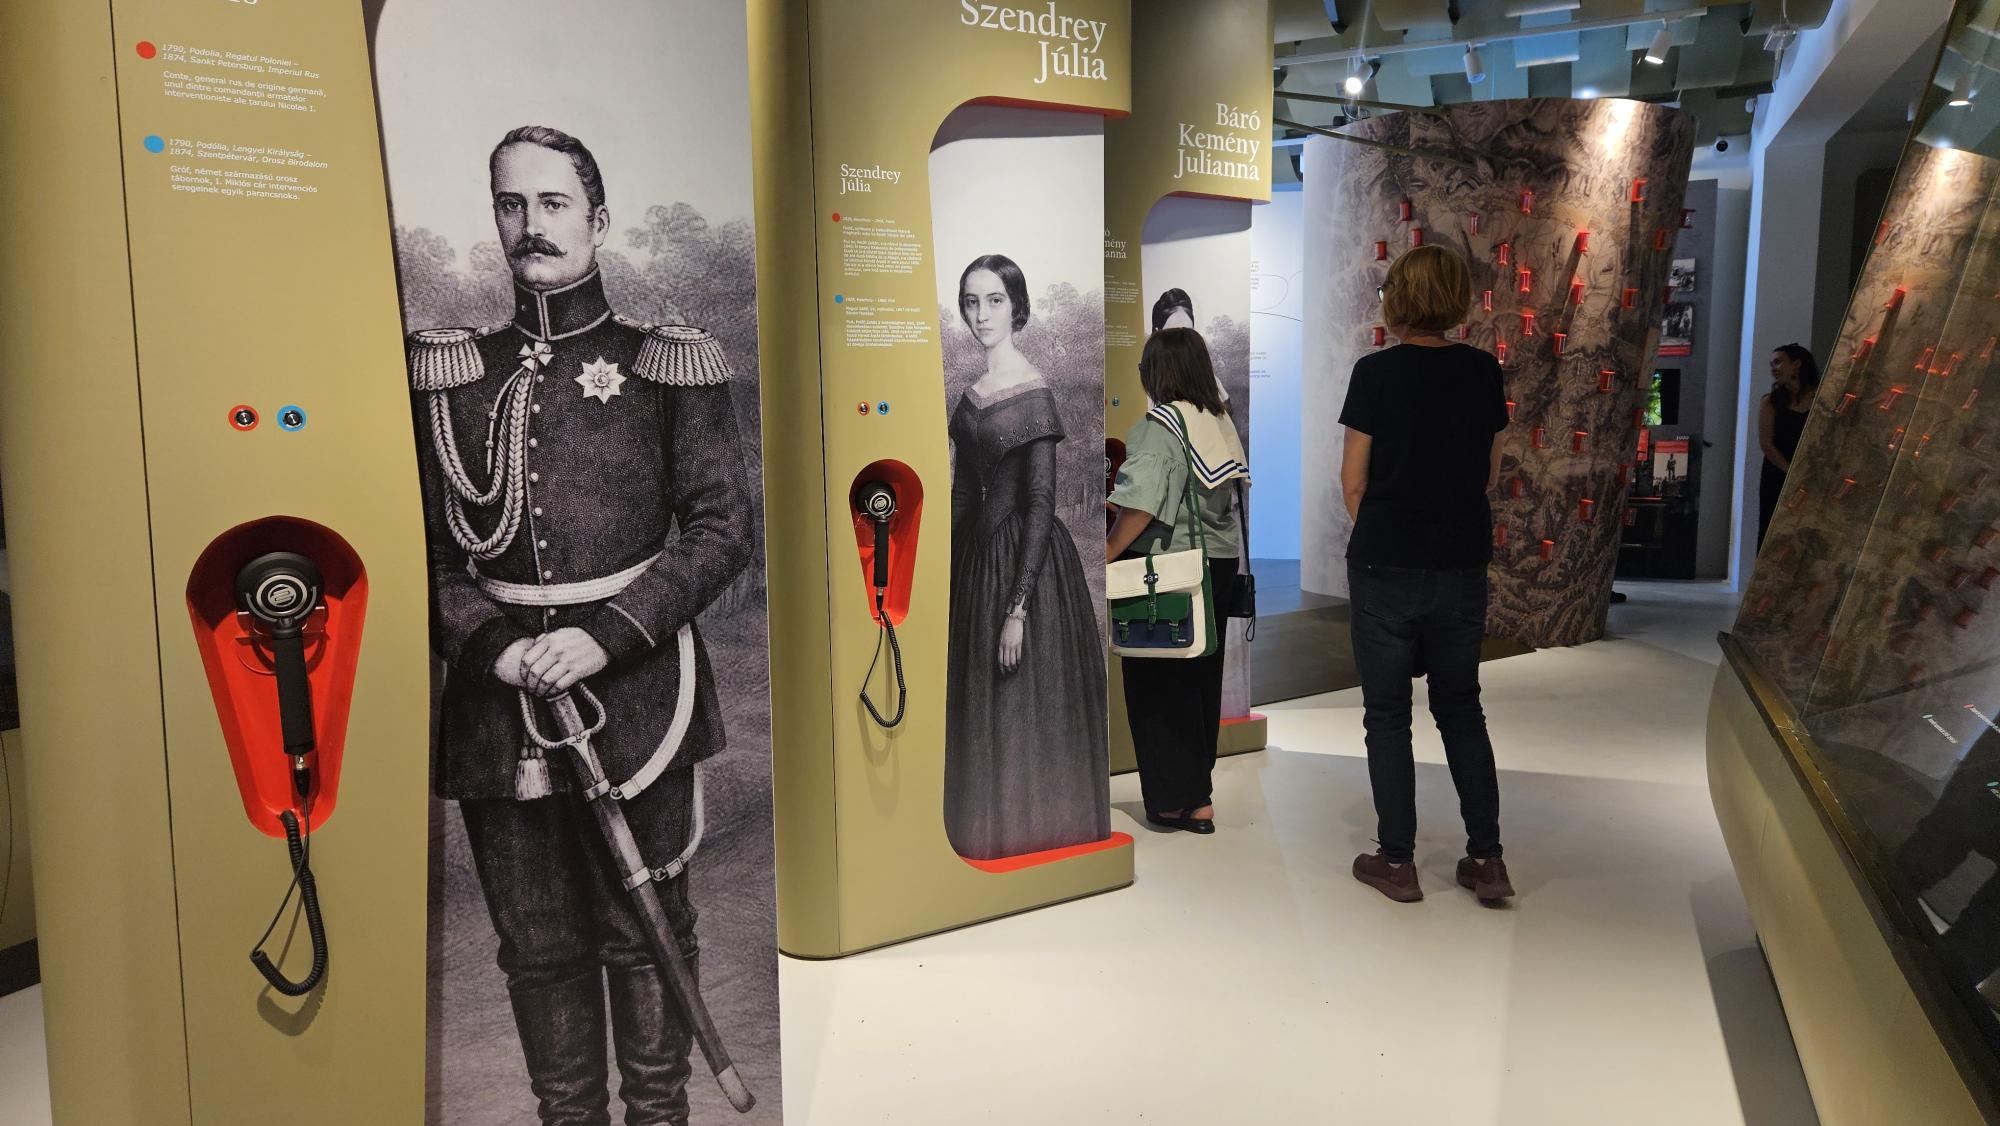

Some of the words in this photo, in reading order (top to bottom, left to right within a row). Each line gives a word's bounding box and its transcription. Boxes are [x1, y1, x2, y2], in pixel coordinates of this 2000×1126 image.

[960, 0, 1107, 52] Szendrey
[162, 43, 186, 55] 1790,
[190, 47, 223, 59] Podolia,
[226, 51, 257, 62] Regatul
[260, 55, 292, 66] Poloniei
[1034, 40, 1108, 83] Júlia
[162, 52, 187, 64] 1874,
[190, 56, 215, 66] Sankt
[218, 59, 265, 73] Petersburg,
[268, 65, 302, 77] Imperiul
[304, 70, 320, 79] Rus
[163, 70, 191, 82] Conte,
[194, 75, 227, 85] general
[228, 79, 243, 87] rus
[245, 80, 255, 88] de
[257, 82, 286, 92] origine
[287, 86, 327, 98] germană,
[164, 81, 183, 89] unul
[185, 82, 212, 92] dintre
[267, 92, 307, 102] armatelor
[234, 96, 247, 104] ale
[278, 100, 307, 111] Nicolae
[1216, 103, 1261, 130] Báró
[169, 138, 193, 149] 1790,
[232, 144, 265, 155] Lengyel
[267, 147, 304, 159] Királyság
[1178, 123, 1260, 162] Kemény
[169, 147, 195, 158] 1874,
[196, 150, 258, 164] Szentpétervár,
[262, 155, 286, 165] Orosz
[287, 157, 328, 168] Birodalom
[1174, 148, 1260, 181] Julianna
[170, 165, 192, 176] Gróf,
[195, 167, 222, 177] német
[224, 170, 273, 180] származású
[171, 174, 213, 186] tábornok,
[225, 178, 251, 188] Miklós
[253, 181, 267, 189] cár
[269, 181, 318, 192] intervenciós
[840, 163, 901, 184] Szendrey
[221, 187, 244, 197] egyik
[246, 190, 300, 200] parancsnoka.
[840, 177, 872, 195] Júlia
[1104, 238, 1127, 251] mény
